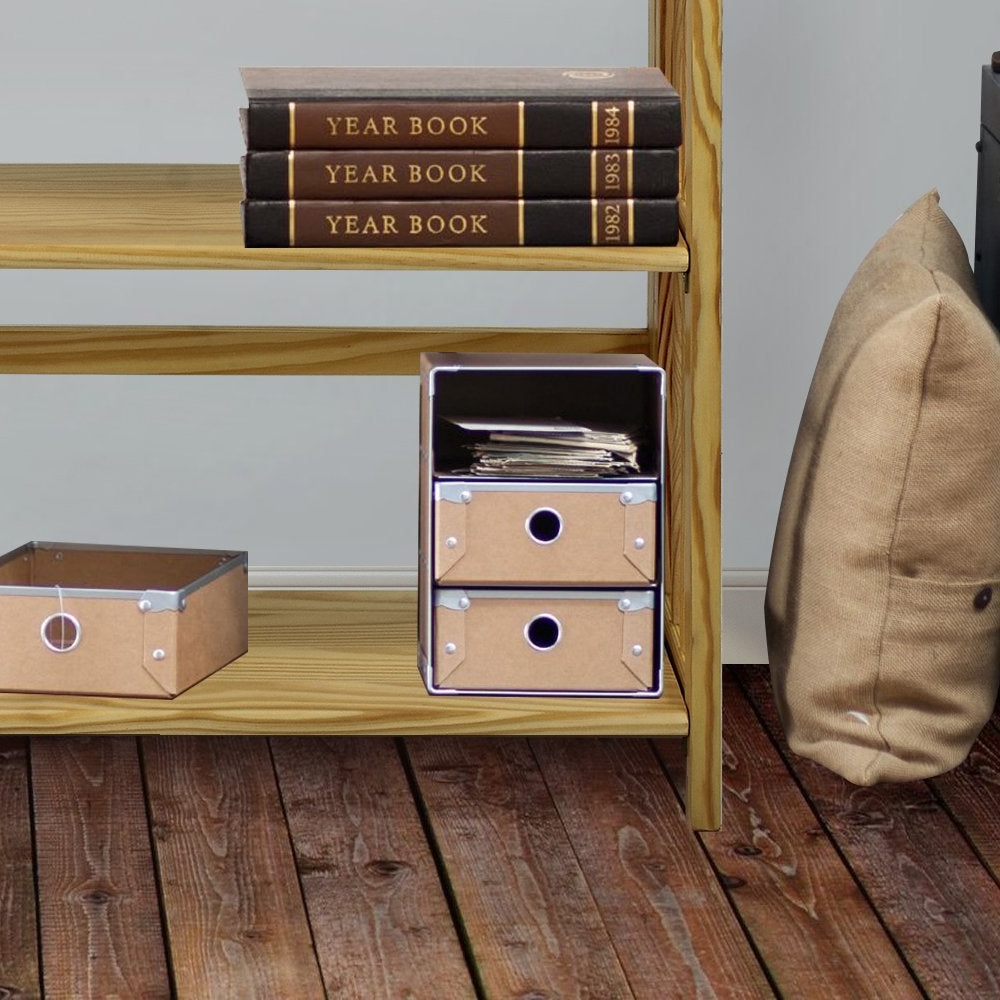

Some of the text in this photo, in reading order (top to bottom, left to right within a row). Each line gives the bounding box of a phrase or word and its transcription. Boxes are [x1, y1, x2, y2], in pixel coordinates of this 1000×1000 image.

[326, 116, 488, 135] YEAR BOOK
[605, 106, 620, 145] 1984
[325, 164, 487, 183] YEAR BOOK
[605, 153, 620, 190] 1983
[326, 215, 488, 234] YEAR BOOK
[605, 204, 620, 241] 1982
